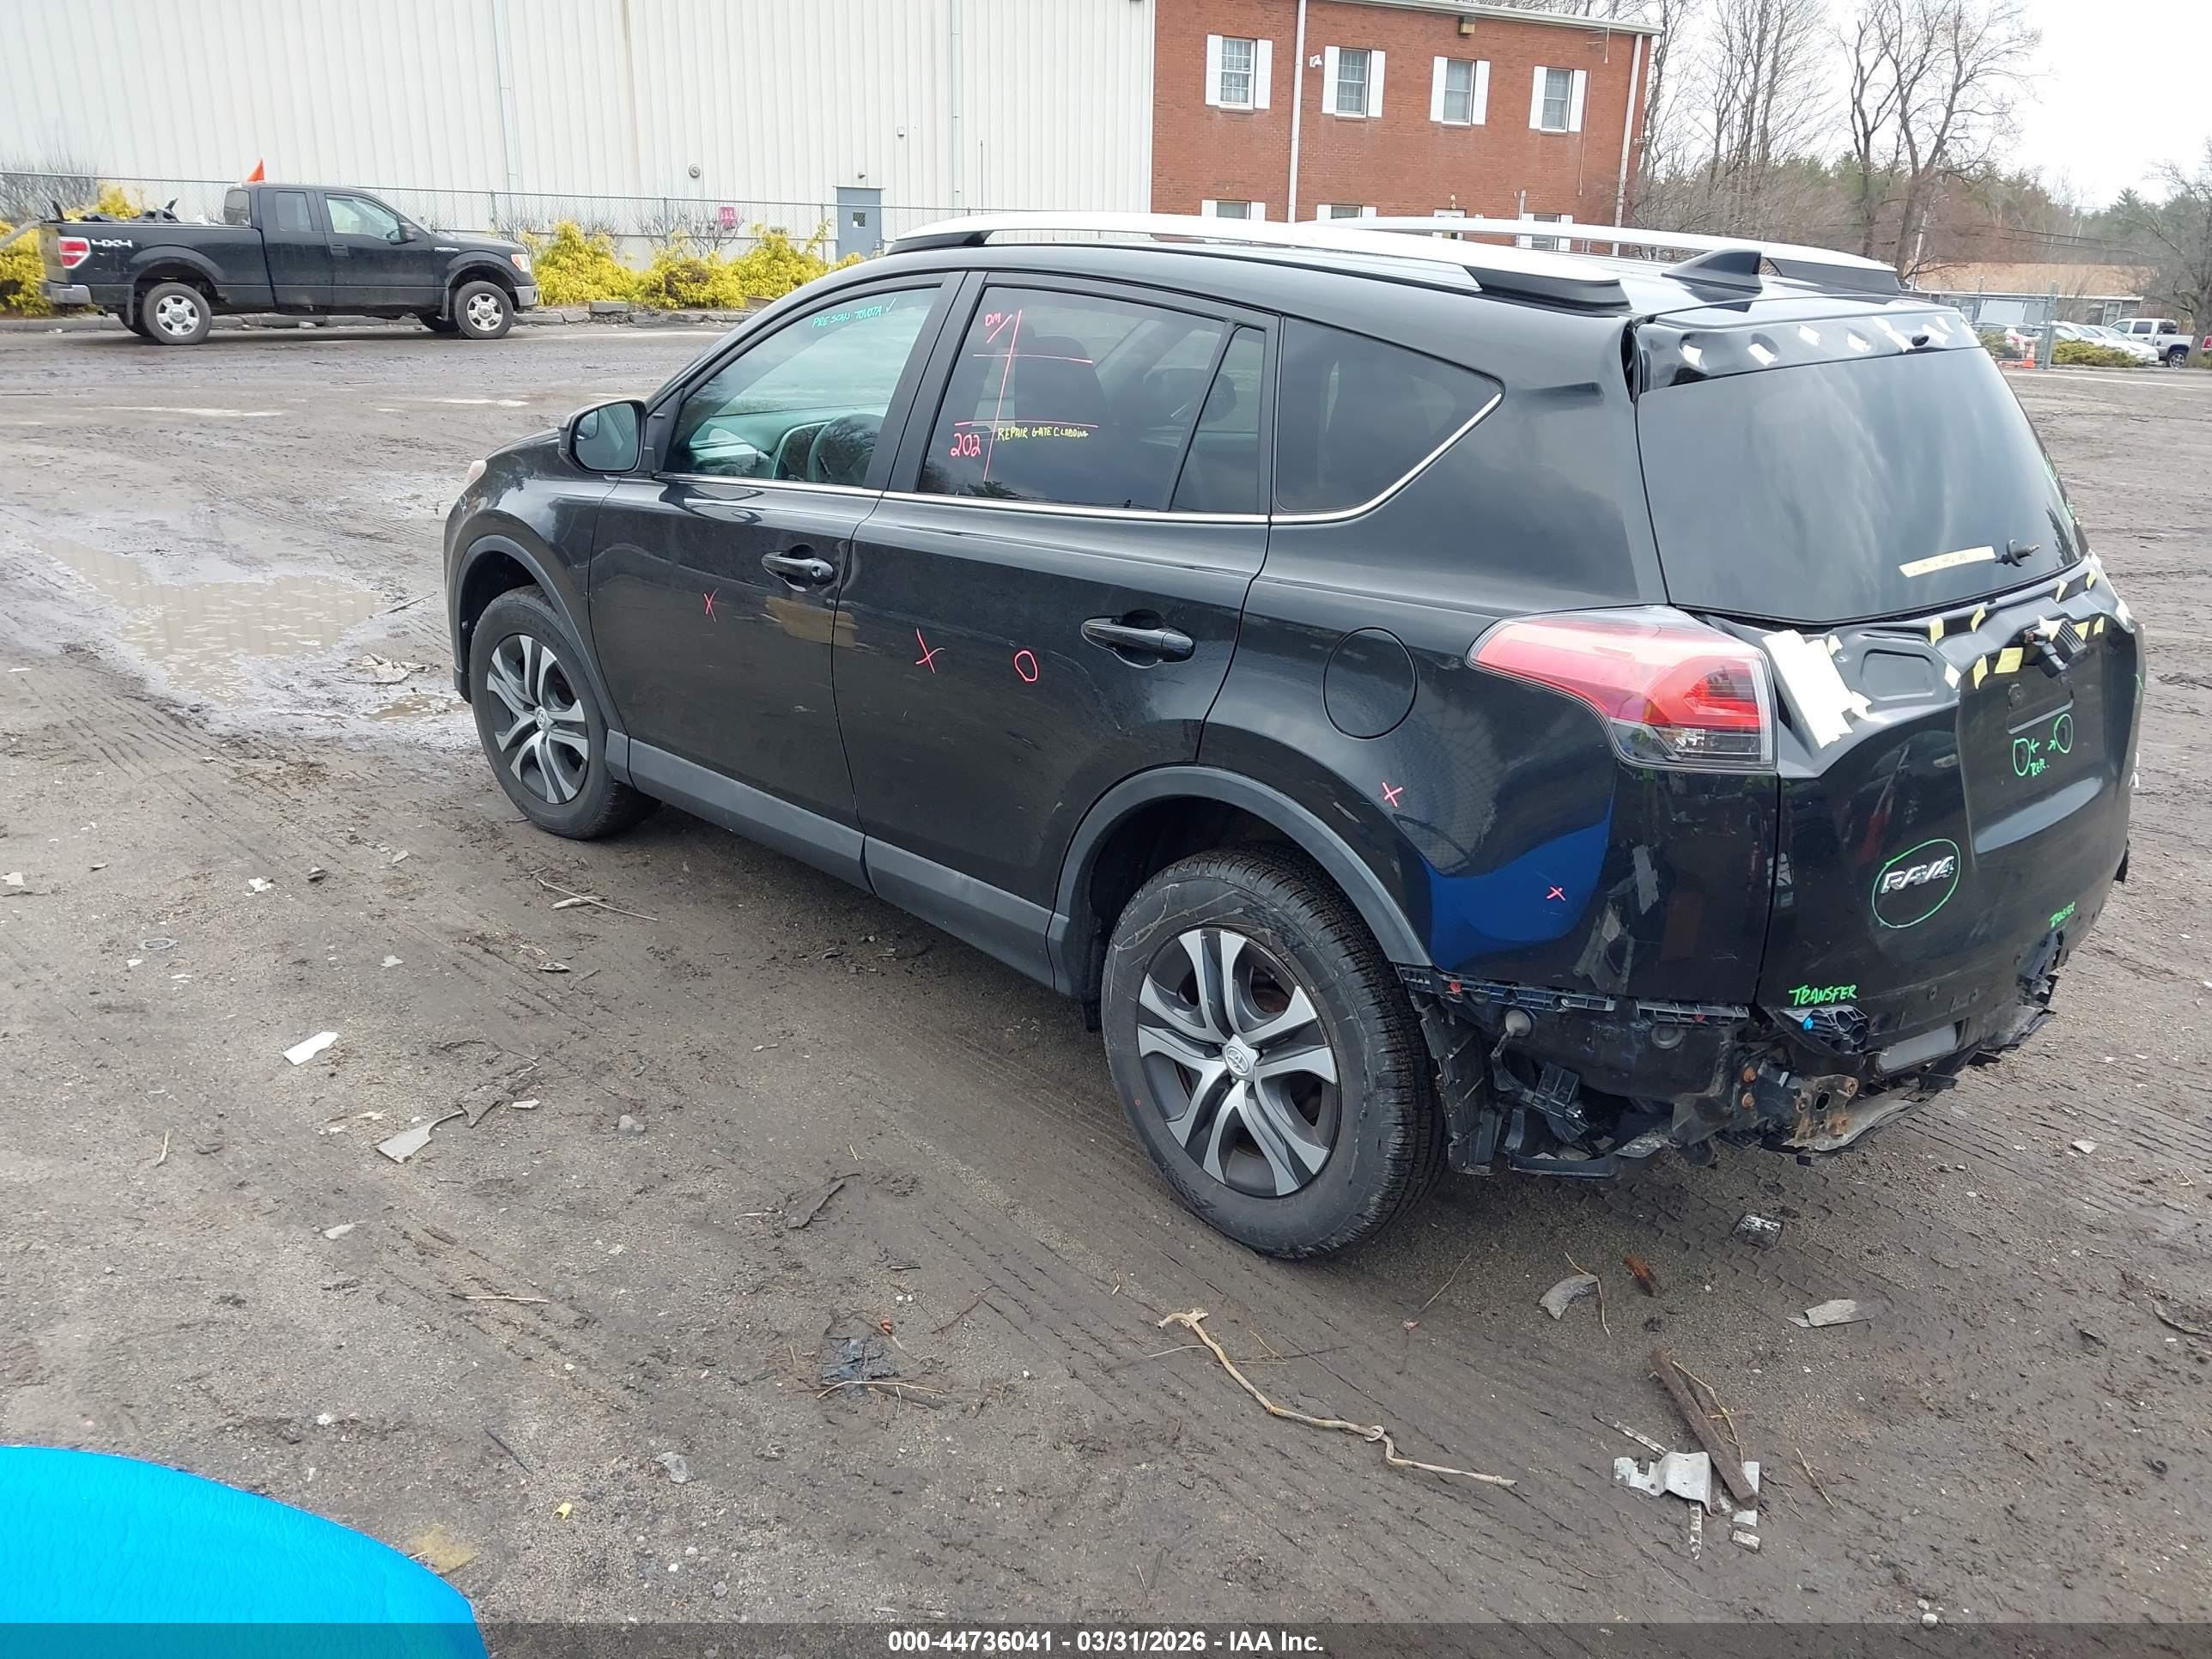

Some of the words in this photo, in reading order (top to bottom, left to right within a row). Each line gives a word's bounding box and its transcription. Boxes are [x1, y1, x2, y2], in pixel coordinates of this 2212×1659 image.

[950, 432, 981, 458] 202
[996, 427, 1030, 442] REPAIR
[1031, 426, 1053, 438] GATE
[1788, 983, 1858, 1006] TRANSFER
